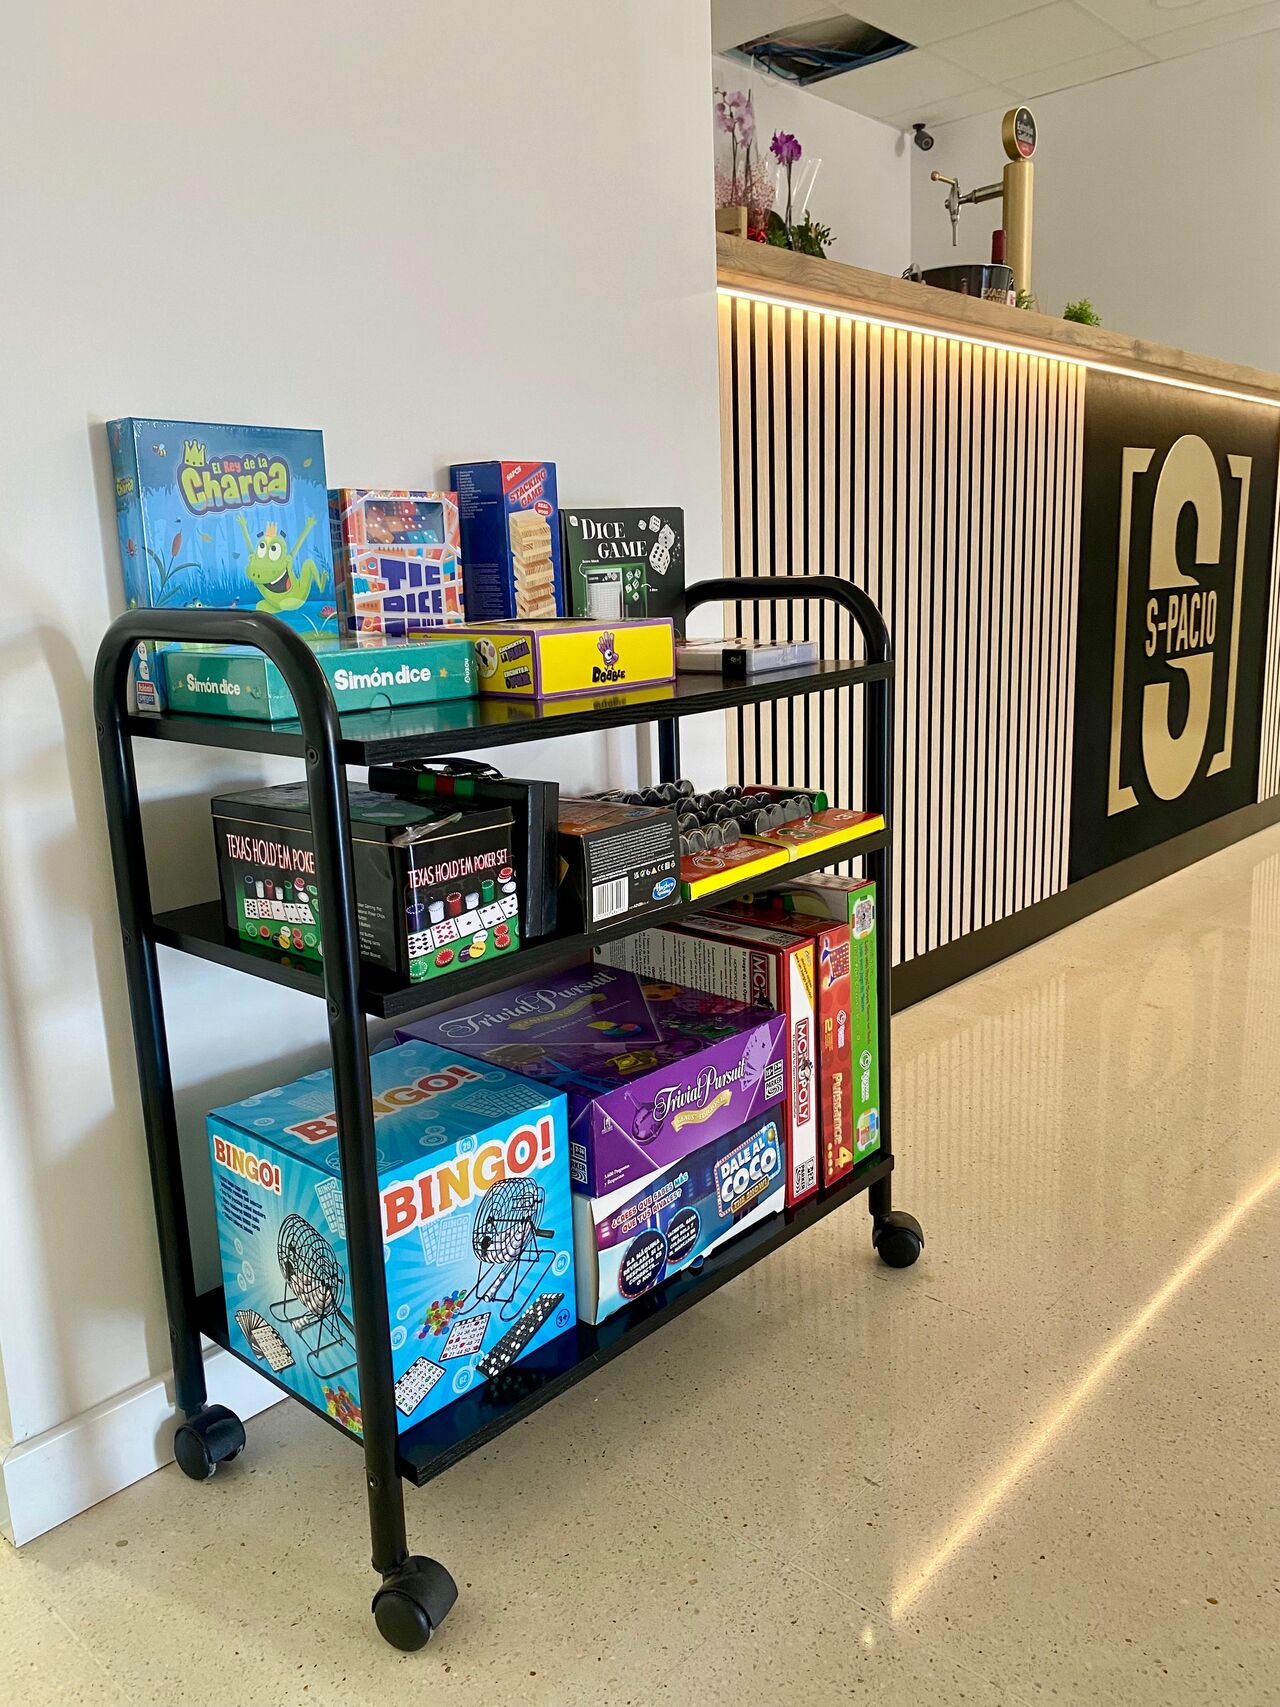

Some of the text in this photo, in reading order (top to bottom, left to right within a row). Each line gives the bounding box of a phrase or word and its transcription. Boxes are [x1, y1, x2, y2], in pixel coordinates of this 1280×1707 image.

[212, 456, 268, 474] El Rey de la
[181, 462, 287, 511] Charca
[509, 470, 547, 502] STACKING
[520, 485, 544, 508] GAME
[581, 518, 626, 540] DICE
[597, 541, 647, 558] GAME
[382, 589, 444, 614] DICE
[1145, 590, 1217, 657] S-PACIO
[186, 673, 240, 696] Simón dice
[334, 664, 432, 690] Simón dice
[226, 833, 315, 874] TEXAS HOLD'EM POKE
[407, 848, 508, 889] TEXAS HOLD'EM POKER SET
[438, 999, 540, 1039] Trivial
[515, 971, 617, 1014] Pursuit
[823, 1016, 833, 1034] 2
[652, 1079, 704, 1122] Trivial
[697, 1057, 746, 1108] Pursuit
[766, 1075, 783, 1089] PARKER
[832, 1072, 853, 1169] Puissance 4
[214, 1137, 281, 1194] BINGO!
[721, 1136, 766, 1179] DALE AL
[721, 1146, 777, 1203] COCO
[384, 1121, 551, 1237] BINGO!
[611, 1171, 689, 1229] ¿CREES QUE SABES MÁS
[622, 1188, 683, 1234] QUE TUS RIVALES?
[656, 1242, 664, 1252] LA
